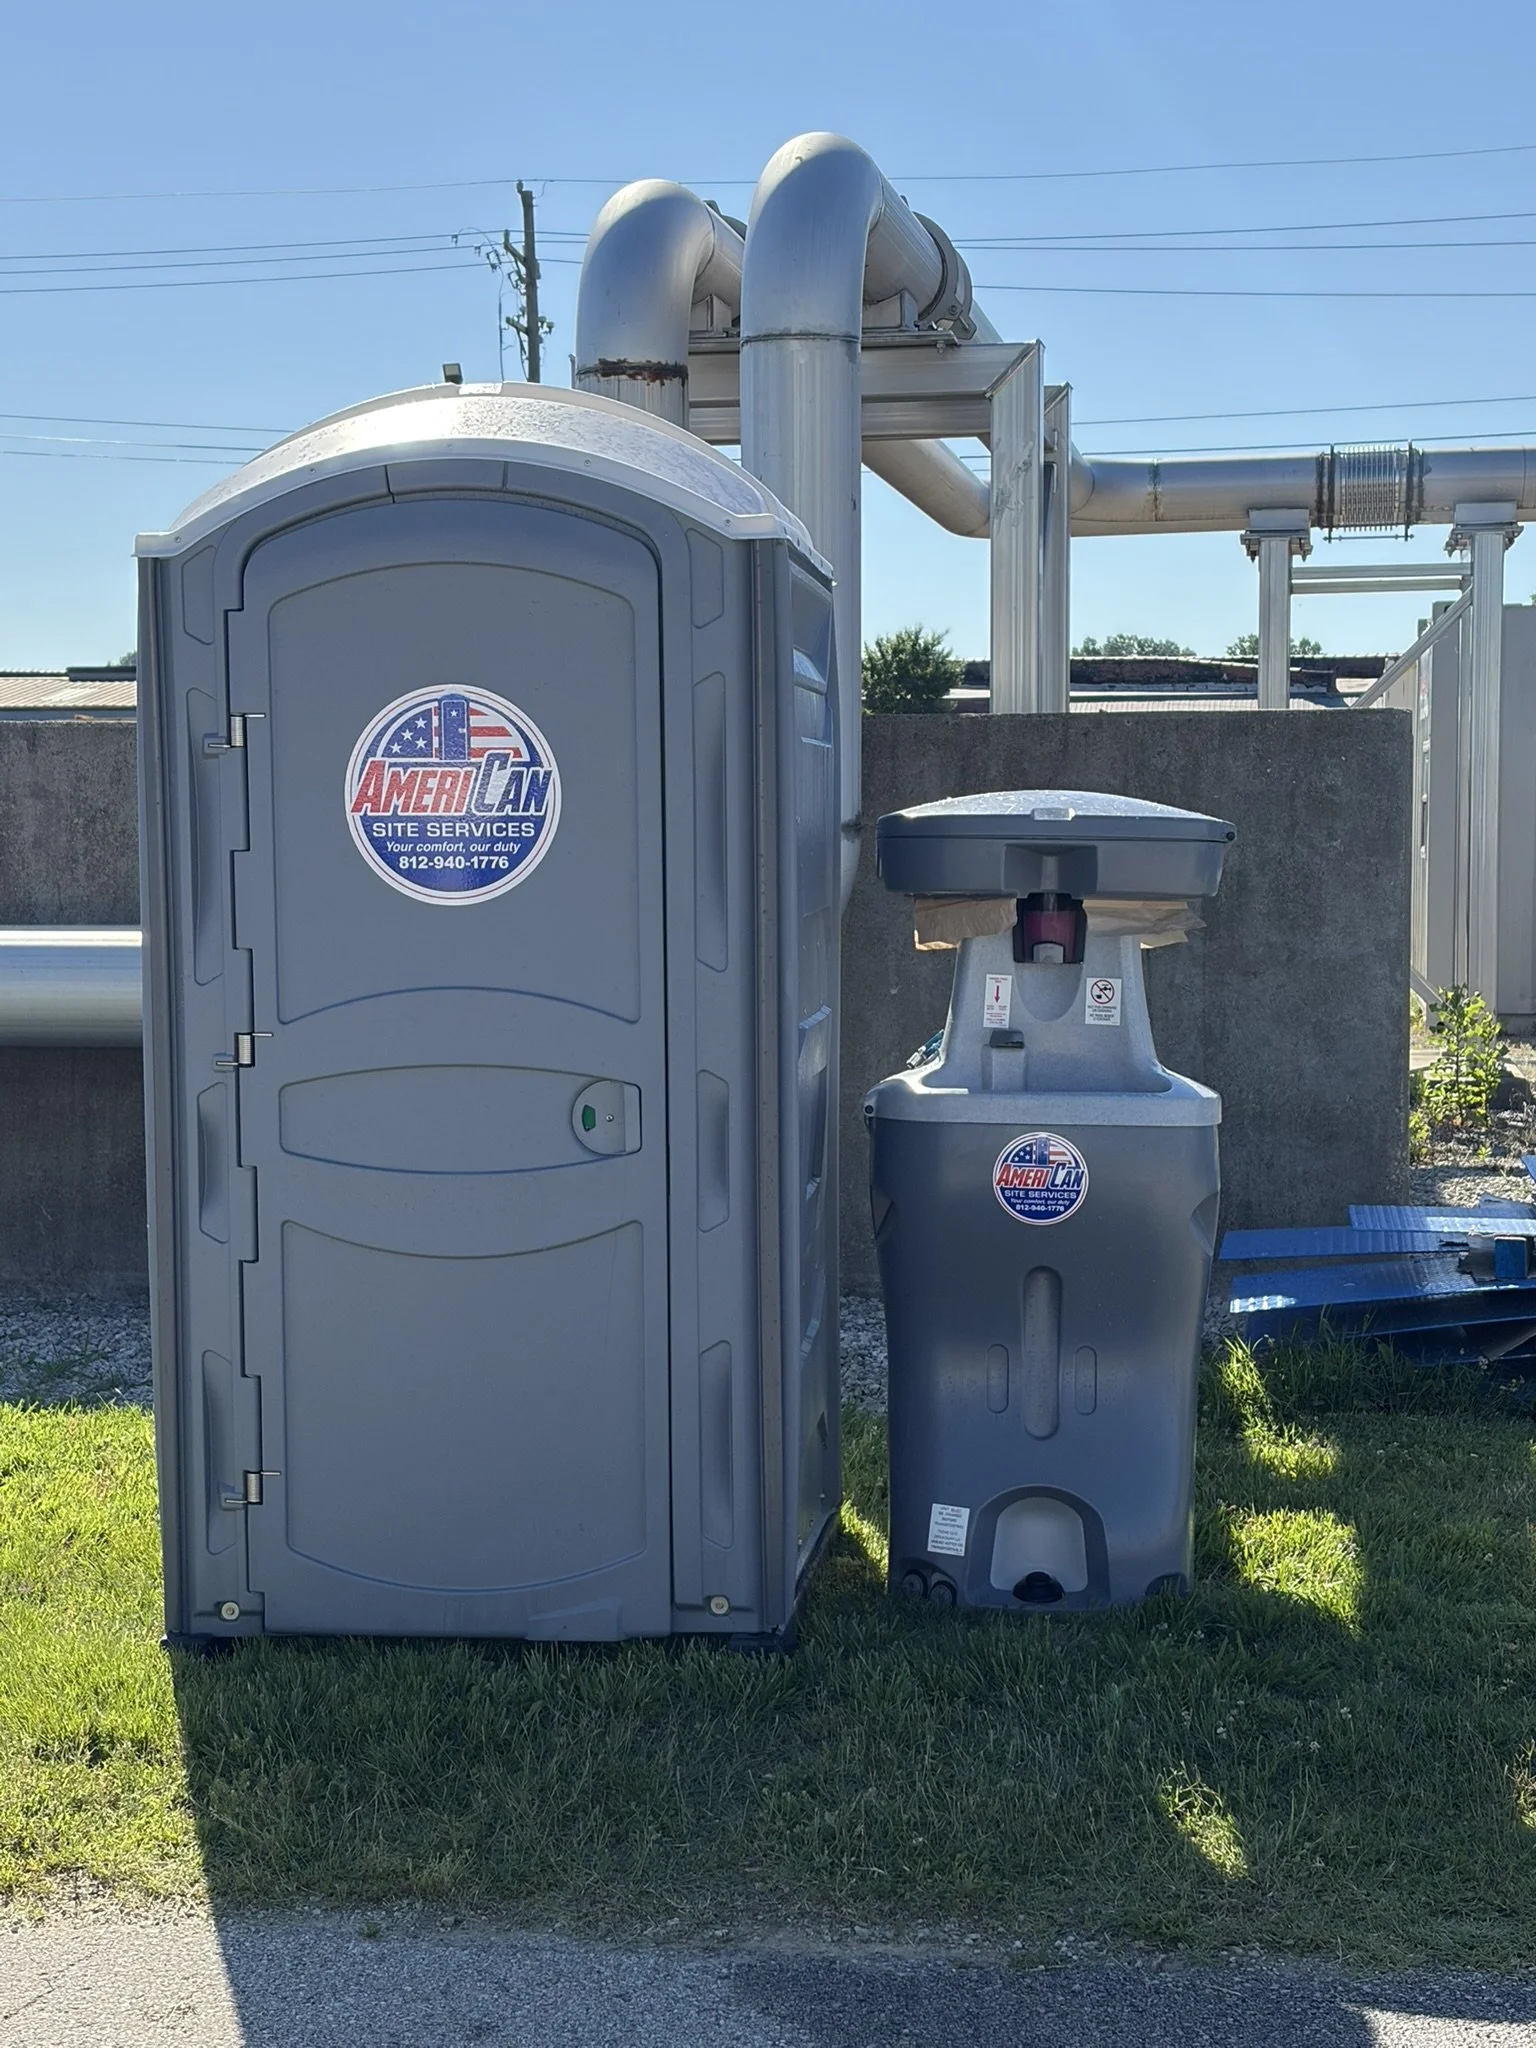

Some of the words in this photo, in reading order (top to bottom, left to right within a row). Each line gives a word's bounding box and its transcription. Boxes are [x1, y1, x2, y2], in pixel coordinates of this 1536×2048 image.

[372, 822, 419, 837] SITE
[427, 822, 535, 837] SERVICES
[386, 841, 414, 852] Your
[416, 841, 466, 853] comfort,
[469, 843, 491, 852] our
[493, 841, 520, 854] duty
[399, 856, 509, 869] 812-940-1776
